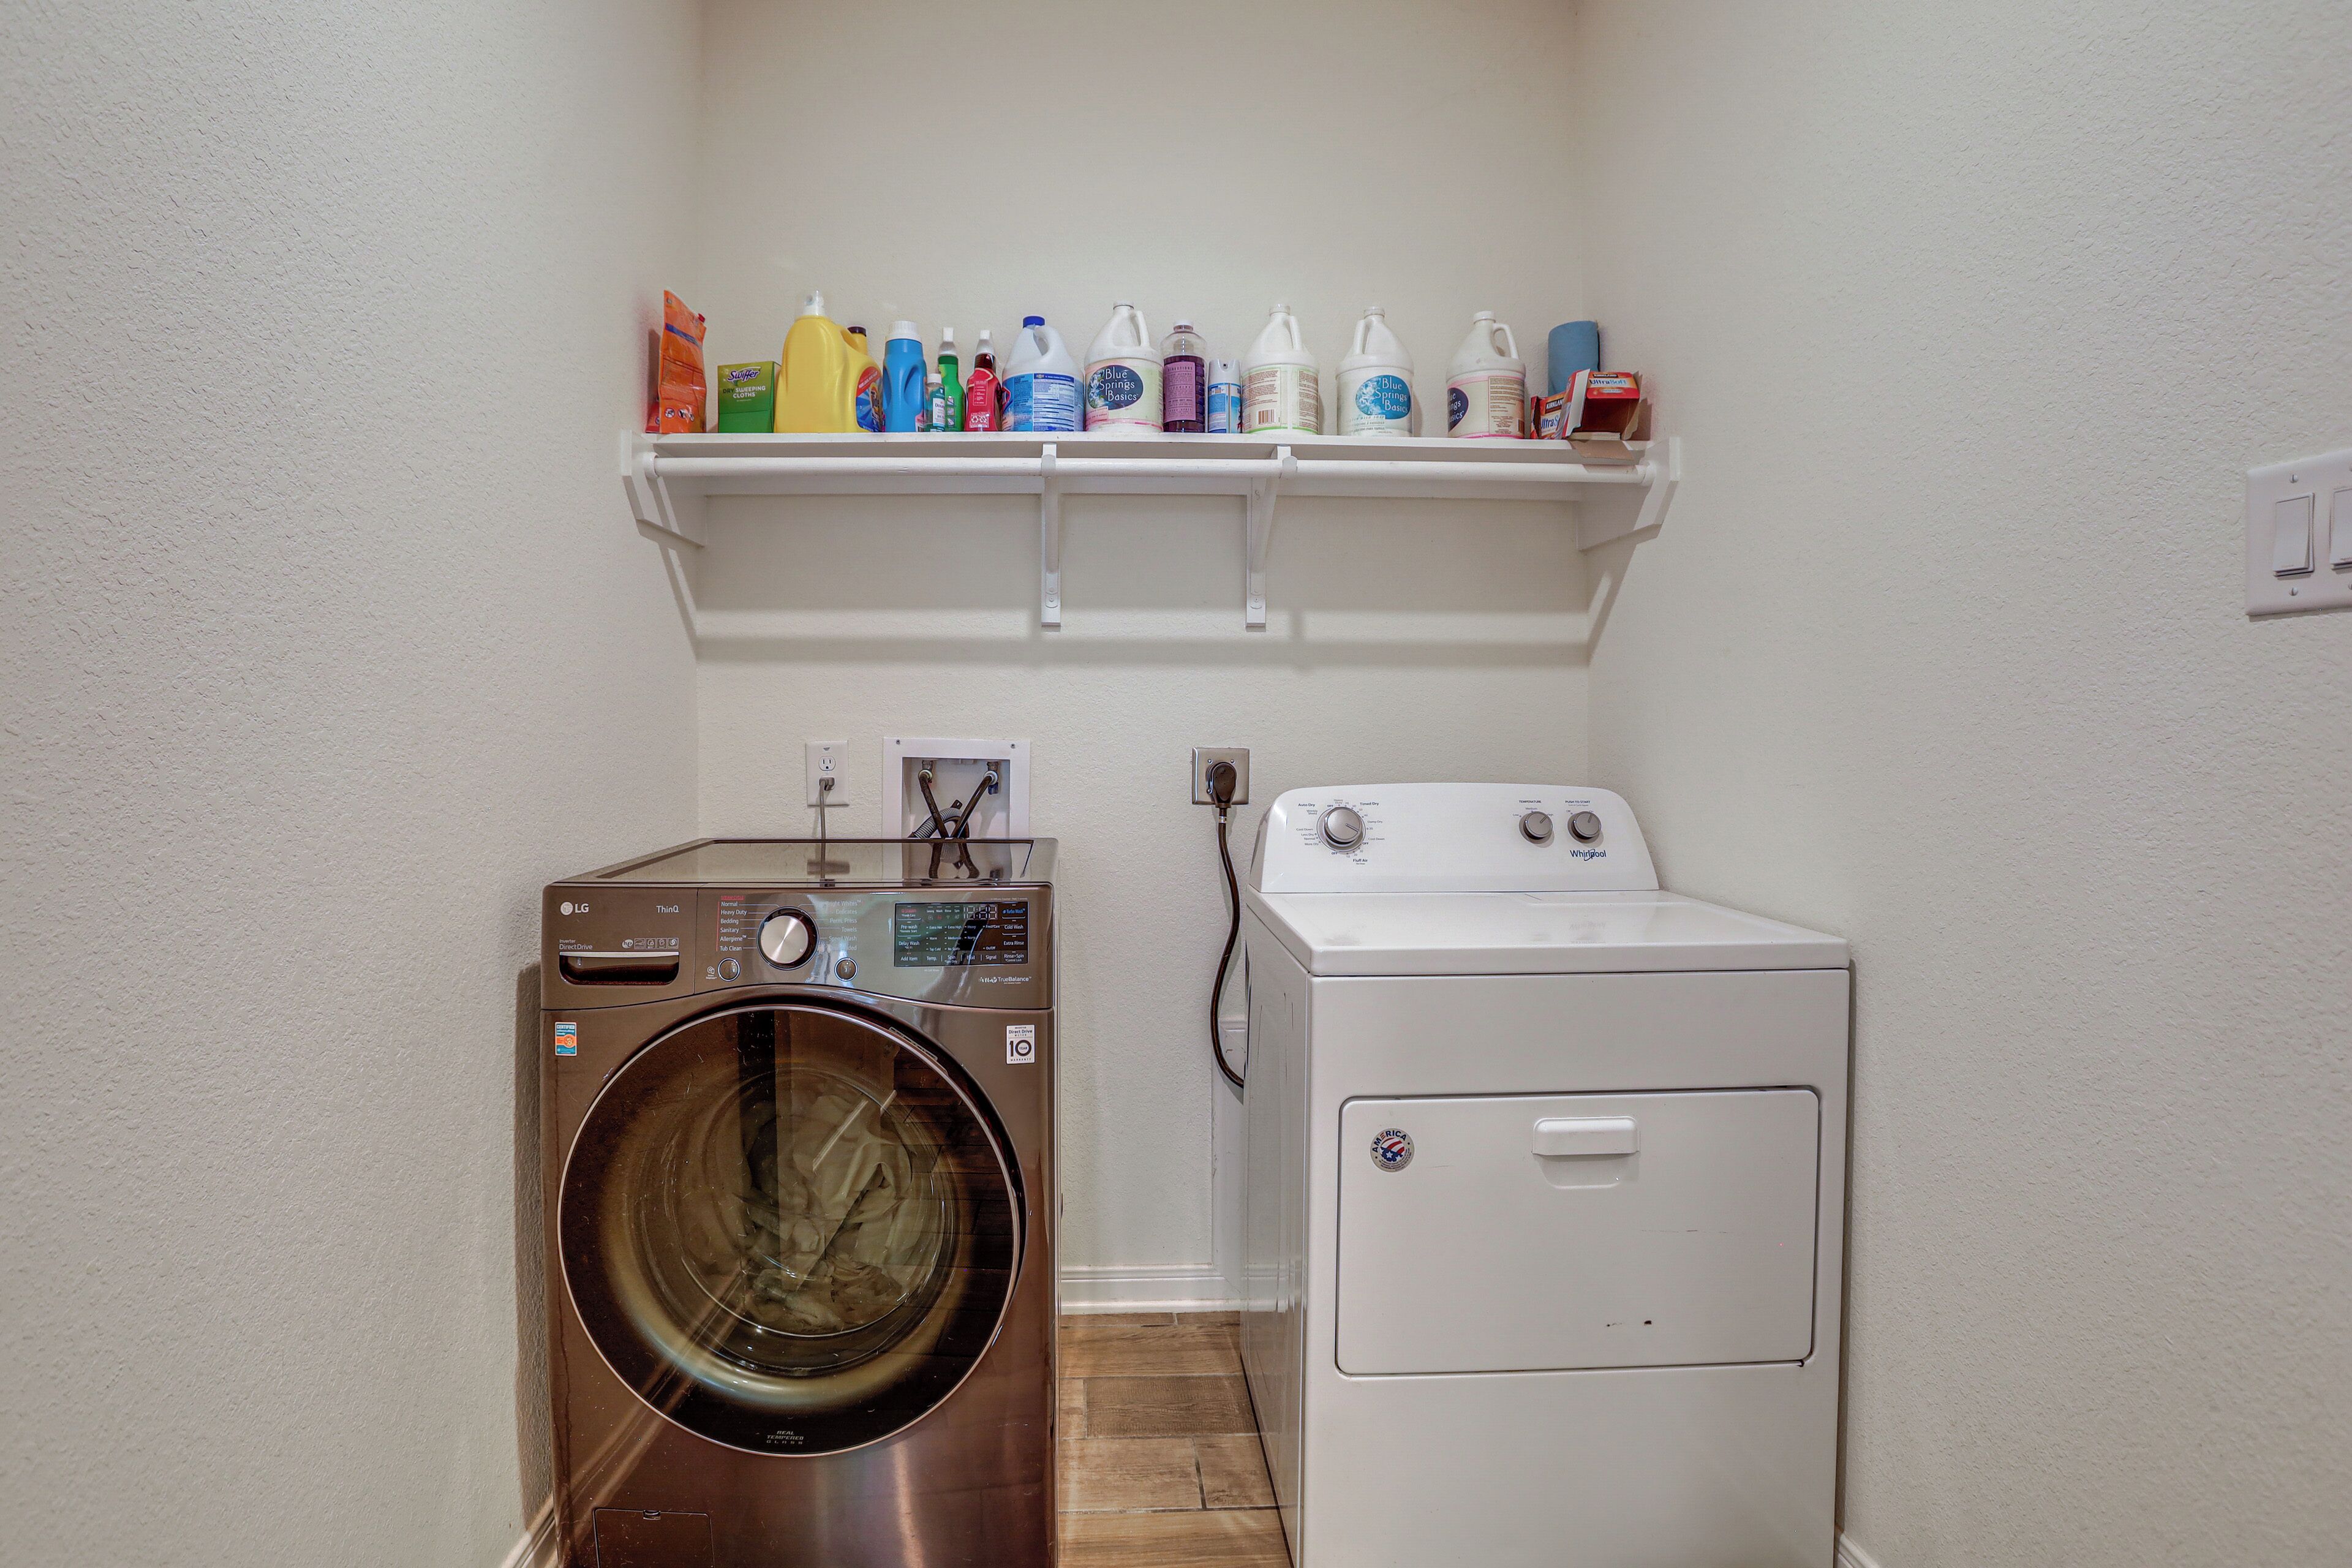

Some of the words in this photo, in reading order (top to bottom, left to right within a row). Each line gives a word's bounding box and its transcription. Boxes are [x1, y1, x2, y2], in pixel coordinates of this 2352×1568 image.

[727, 369, 759, 382] Swiffer
[1106, 366, 1127, 380] Blue
[1099, 379, 1135, 396] Springs
[1382, 377, 1402, 390] Blue
[1108, 390, 1137, 401] Basics
[1375, 387, 1407, 404] Springs
[1385, 400, 1408, 413] Basics
[1570, 850, 1607, 861] Whirlpool
[575, 903, 589, 913] LG
[1009, 1039, 1031, 1057] 10
[1372, 1130, 1407, 1153] AMERICA
